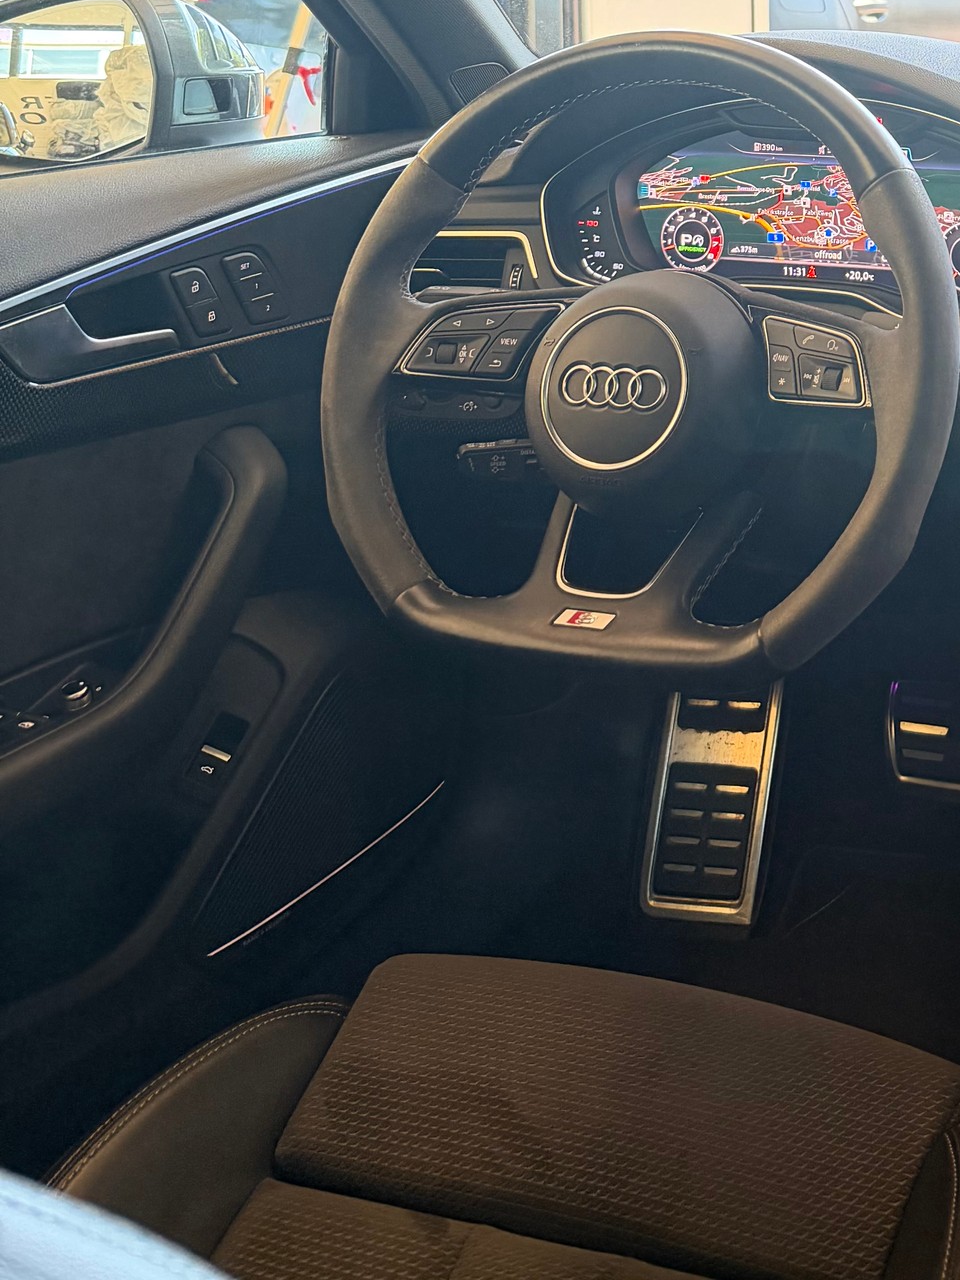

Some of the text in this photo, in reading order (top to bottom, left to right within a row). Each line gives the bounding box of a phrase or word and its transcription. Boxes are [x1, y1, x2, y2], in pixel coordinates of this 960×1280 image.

[761, 143, 775, 151] 390
[814, 250, 842, 260] offroad
[240, 262, 250, 270] SET
[783, 266, 806, 277] 11:31
[500, 338, 518, 346] VIEW
[458, 350, 467, 358] OK
